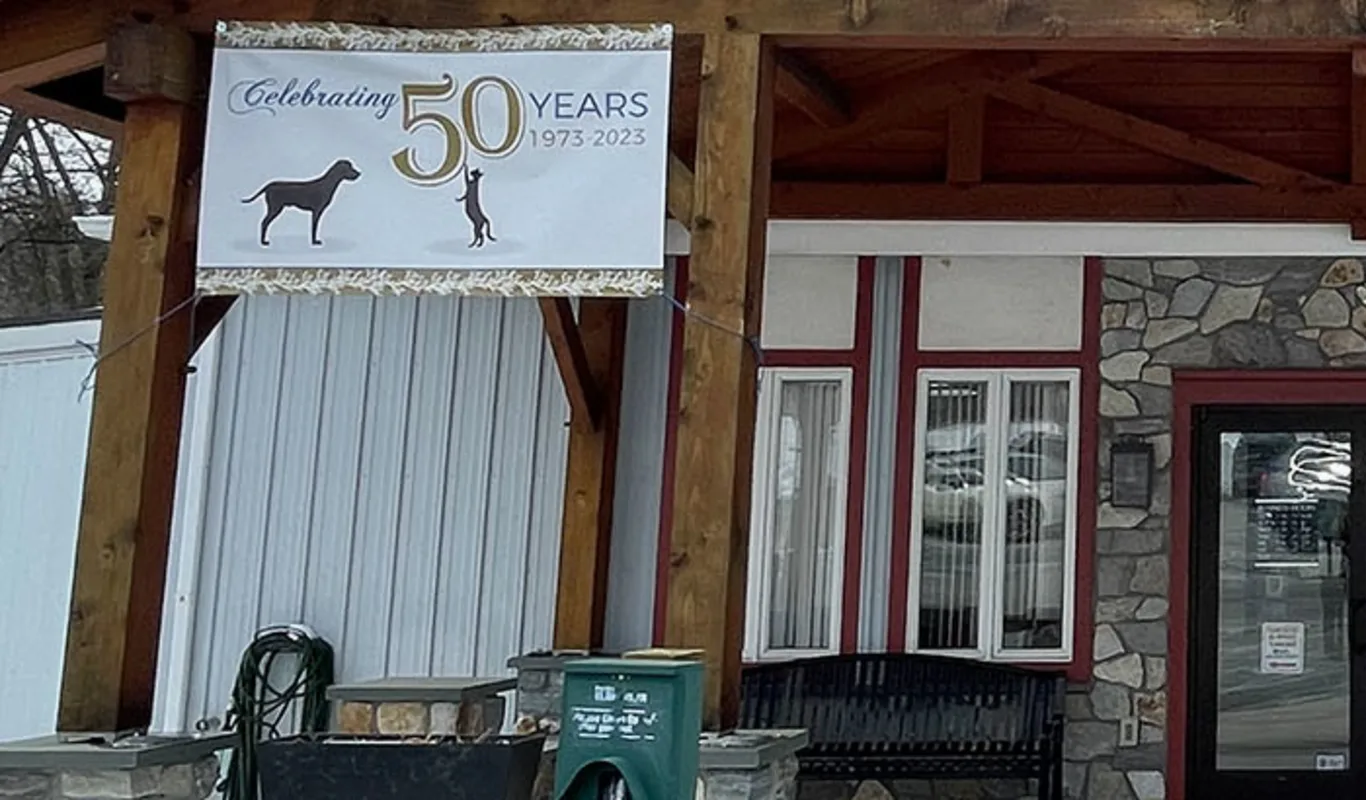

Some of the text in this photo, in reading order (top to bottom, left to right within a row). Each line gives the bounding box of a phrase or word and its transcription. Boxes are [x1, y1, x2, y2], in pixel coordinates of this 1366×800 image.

[228, 73, 649, 186] Celebrating 50 YEARS
[529, 128, 646, 148] 1973-2023
